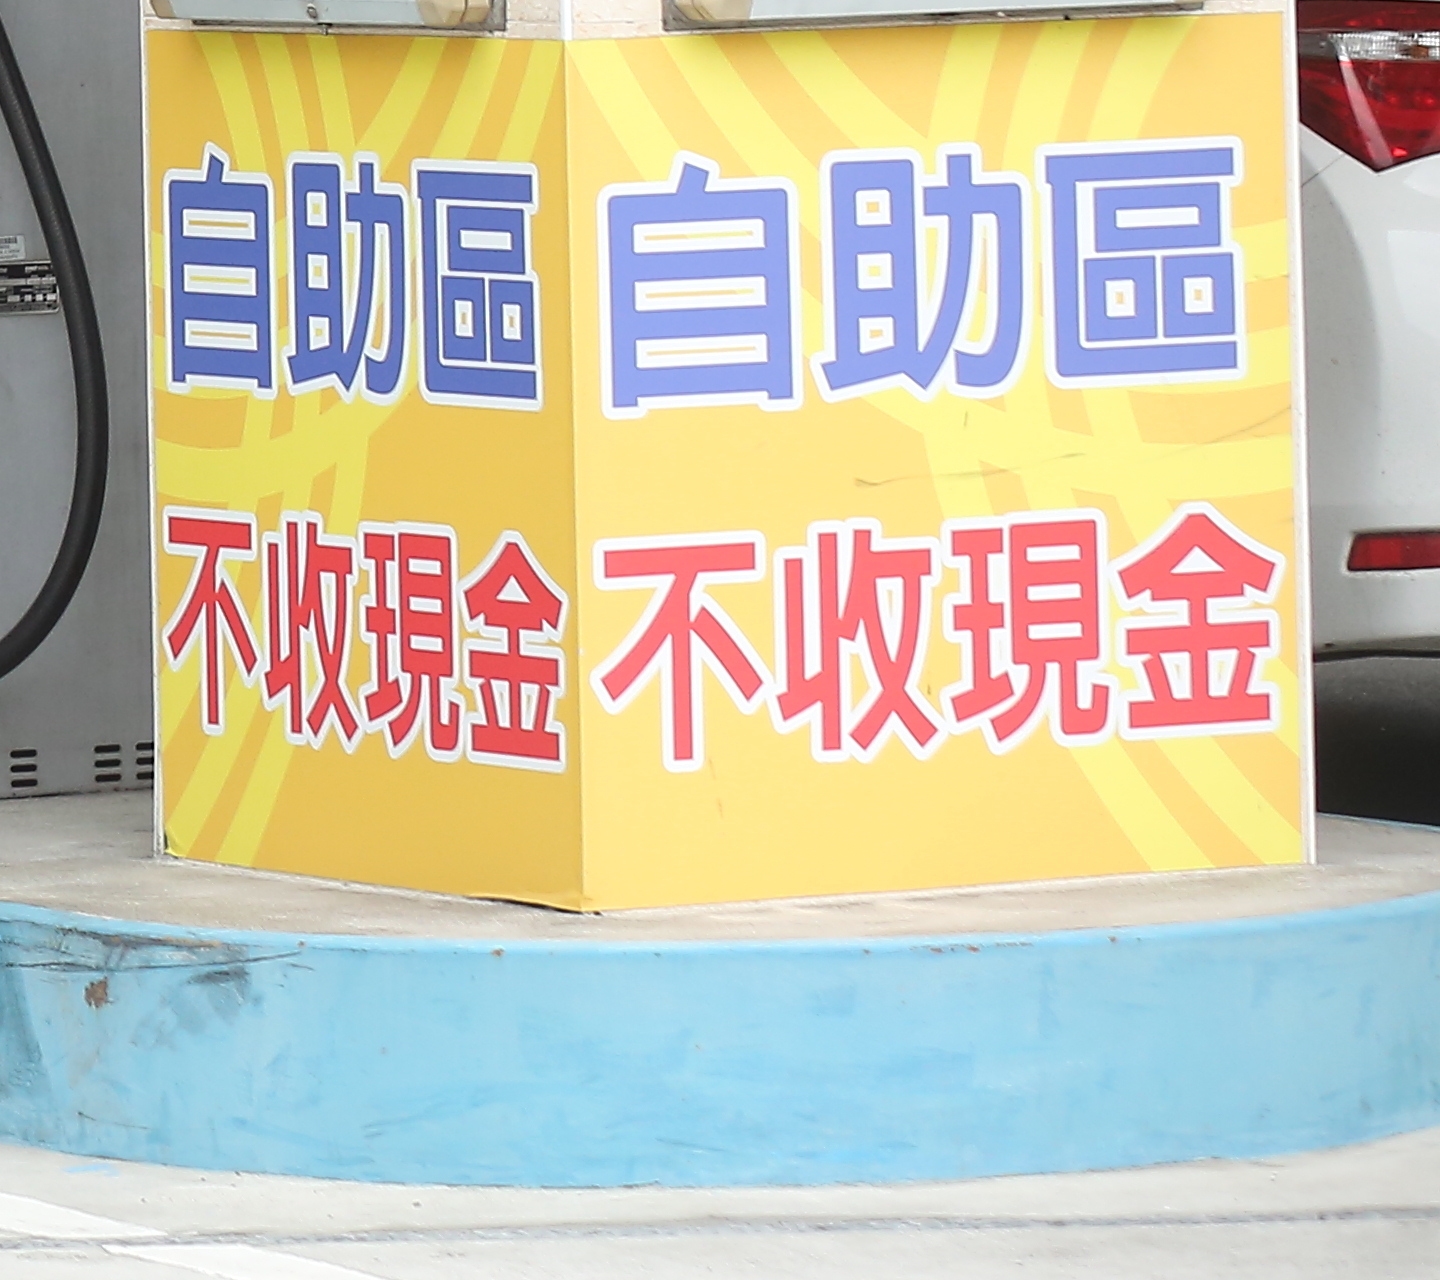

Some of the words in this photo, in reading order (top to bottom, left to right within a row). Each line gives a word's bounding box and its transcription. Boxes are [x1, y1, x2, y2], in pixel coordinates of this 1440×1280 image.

[165, 141, 543, 412] 自助區
[598, 139, 1243, 419] 自助區
[163, 507, 569, 773] 不收現金
[593, 500, 1286, 773] 不收現金
